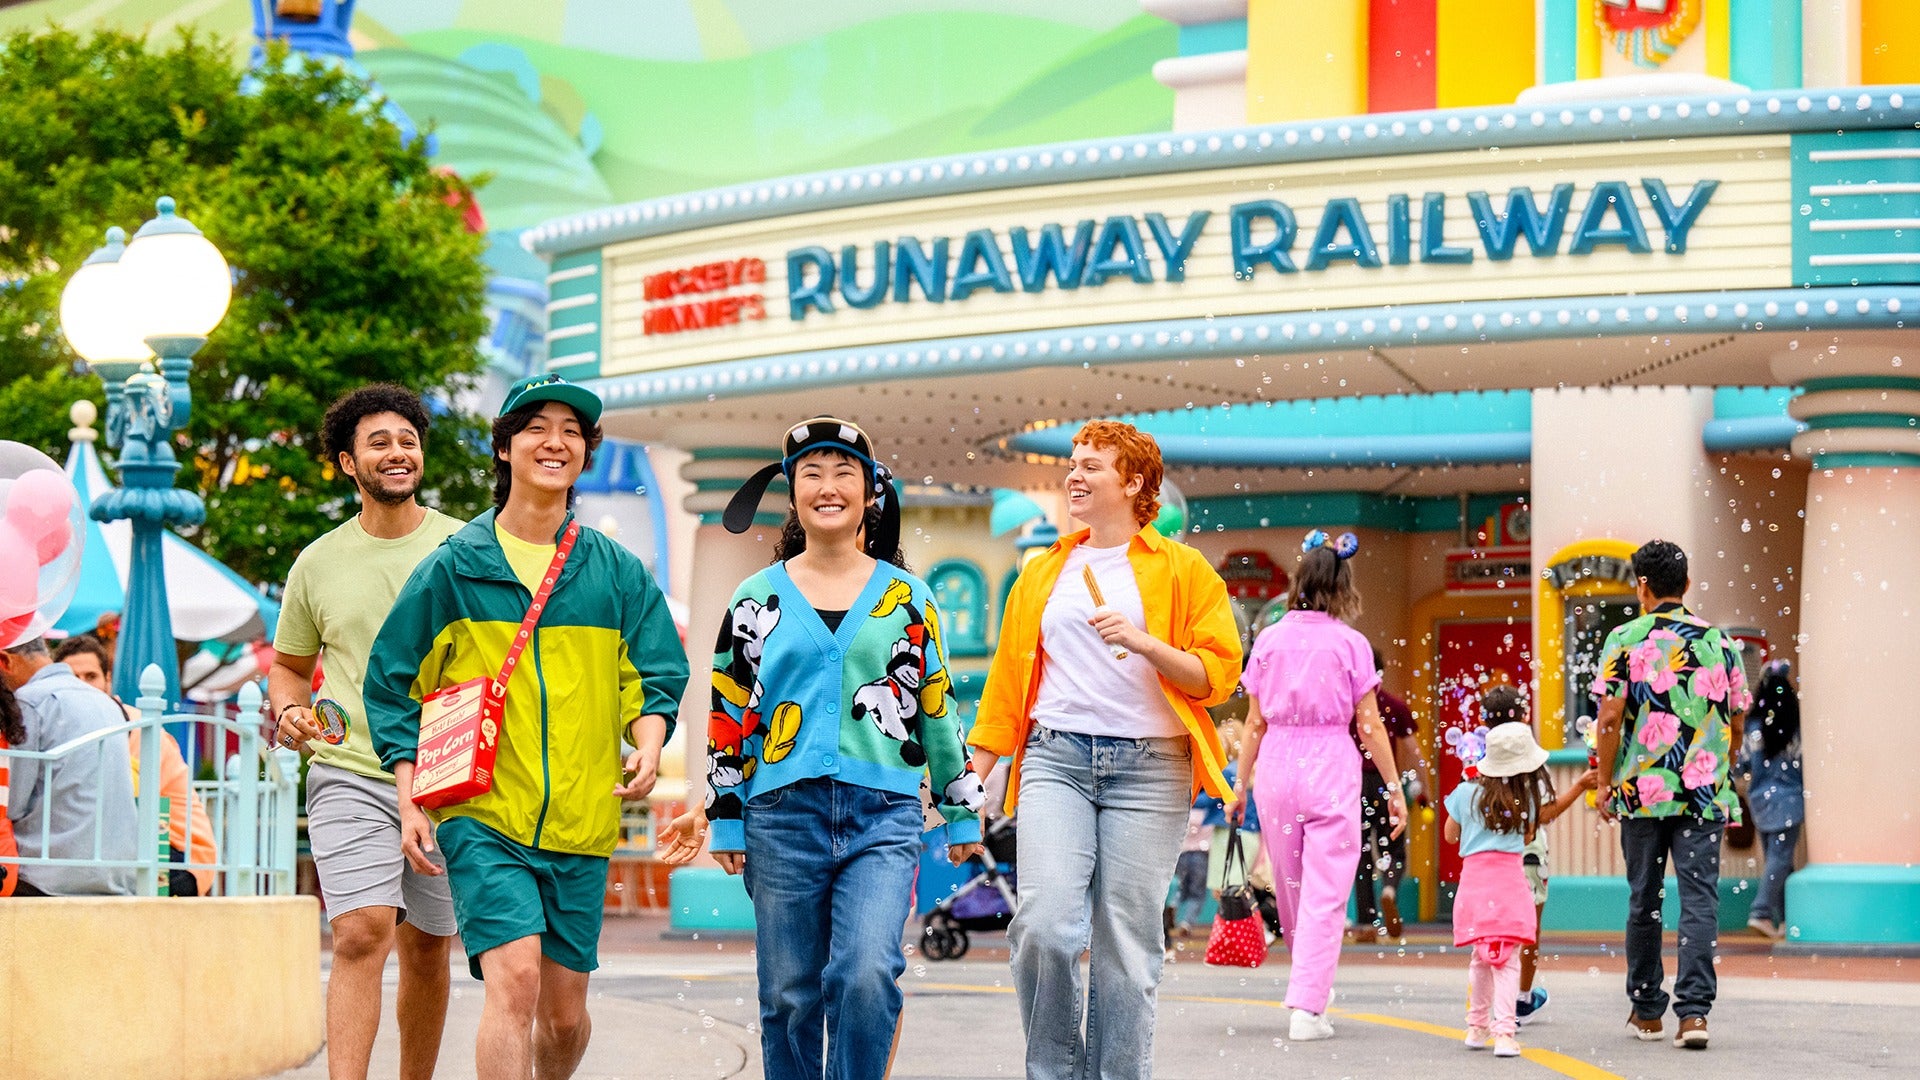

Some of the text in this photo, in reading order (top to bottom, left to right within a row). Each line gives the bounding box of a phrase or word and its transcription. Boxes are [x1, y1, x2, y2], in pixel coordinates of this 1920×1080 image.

[787, 178, 1720, 321] RUNAWAY RAILWAY
[417, 729, 475, 768] Pop Corn
